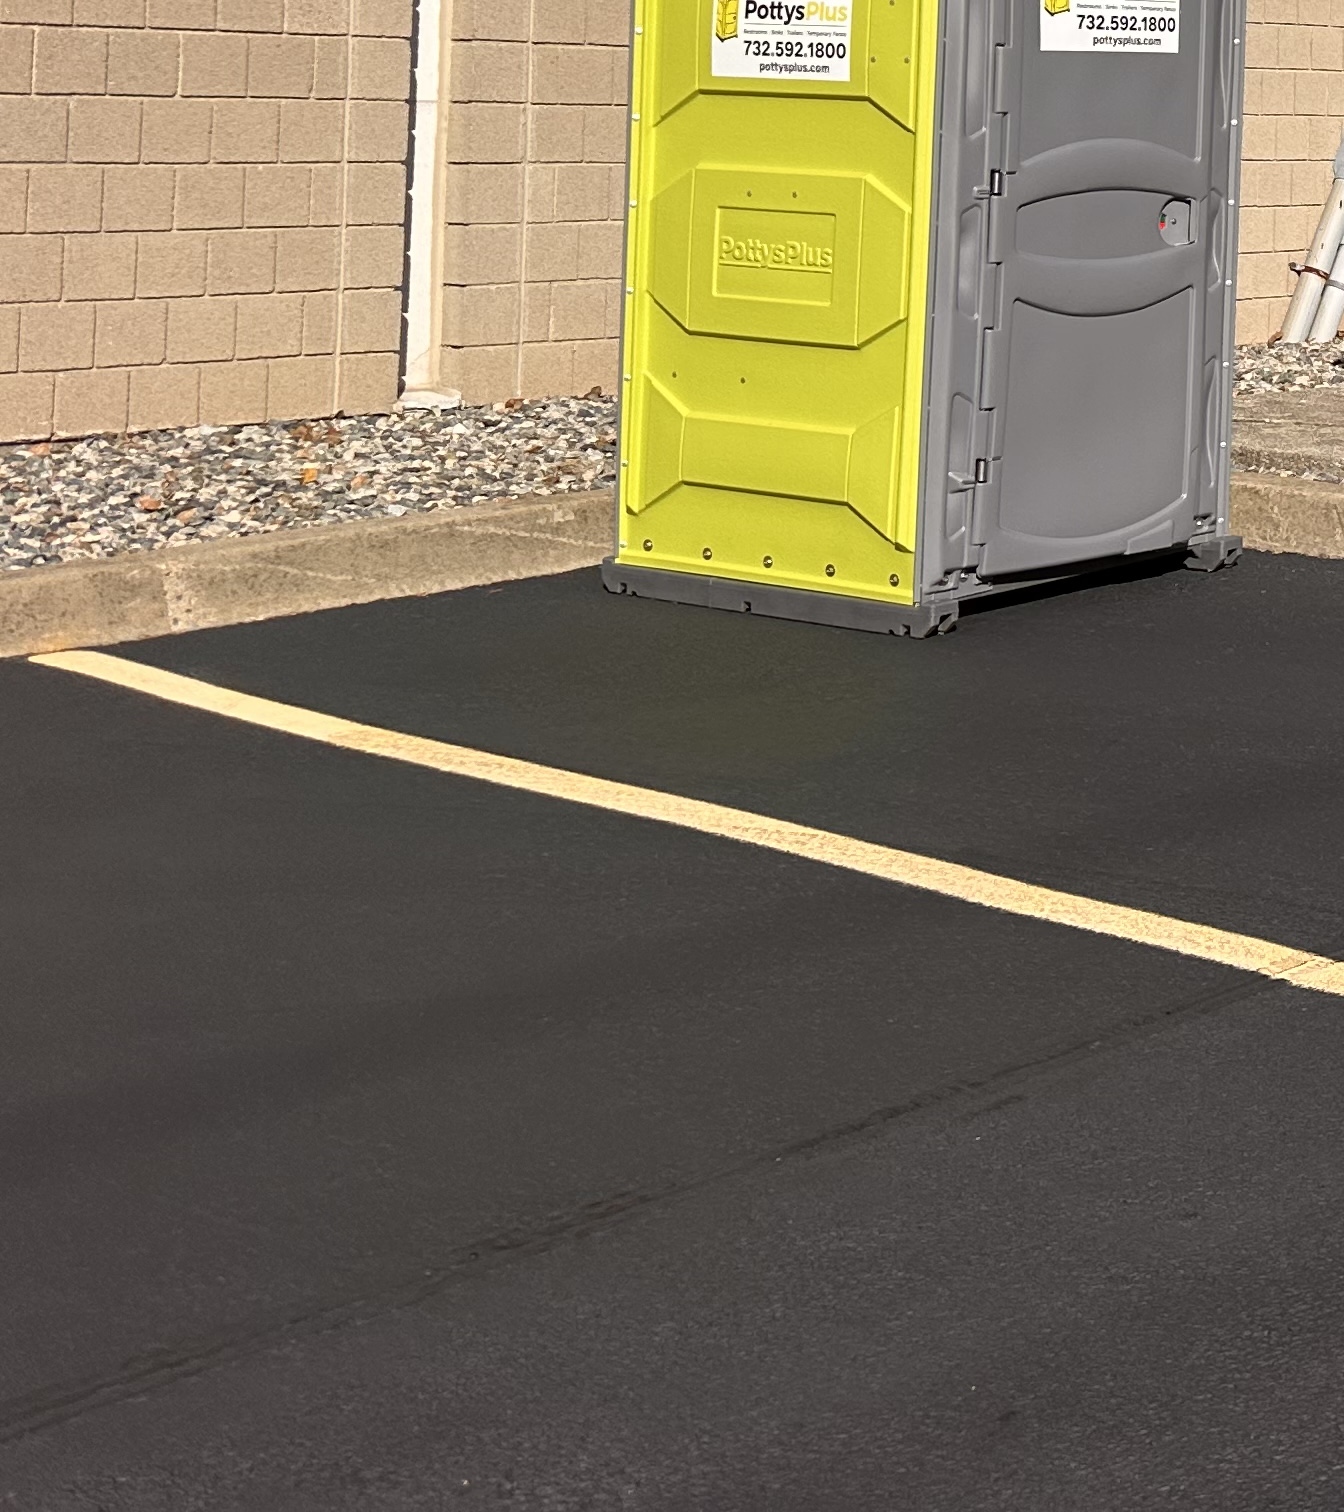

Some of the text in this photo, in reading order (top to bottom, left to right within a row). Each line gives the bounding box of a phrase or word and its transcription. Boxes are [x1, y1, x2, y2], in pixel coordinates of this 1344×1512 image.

[744, 0, 848, 25] PottysPlus
[1077, 14, 1176, 32] 732.592.1800
[743, 40, 847, 59] 732.592.1800
[1093, 36, 1162, 47] pottysplus.com
[759, 62, 830, 74] pottysplus.com
[719, 235, 833, 268] PottysPlus
